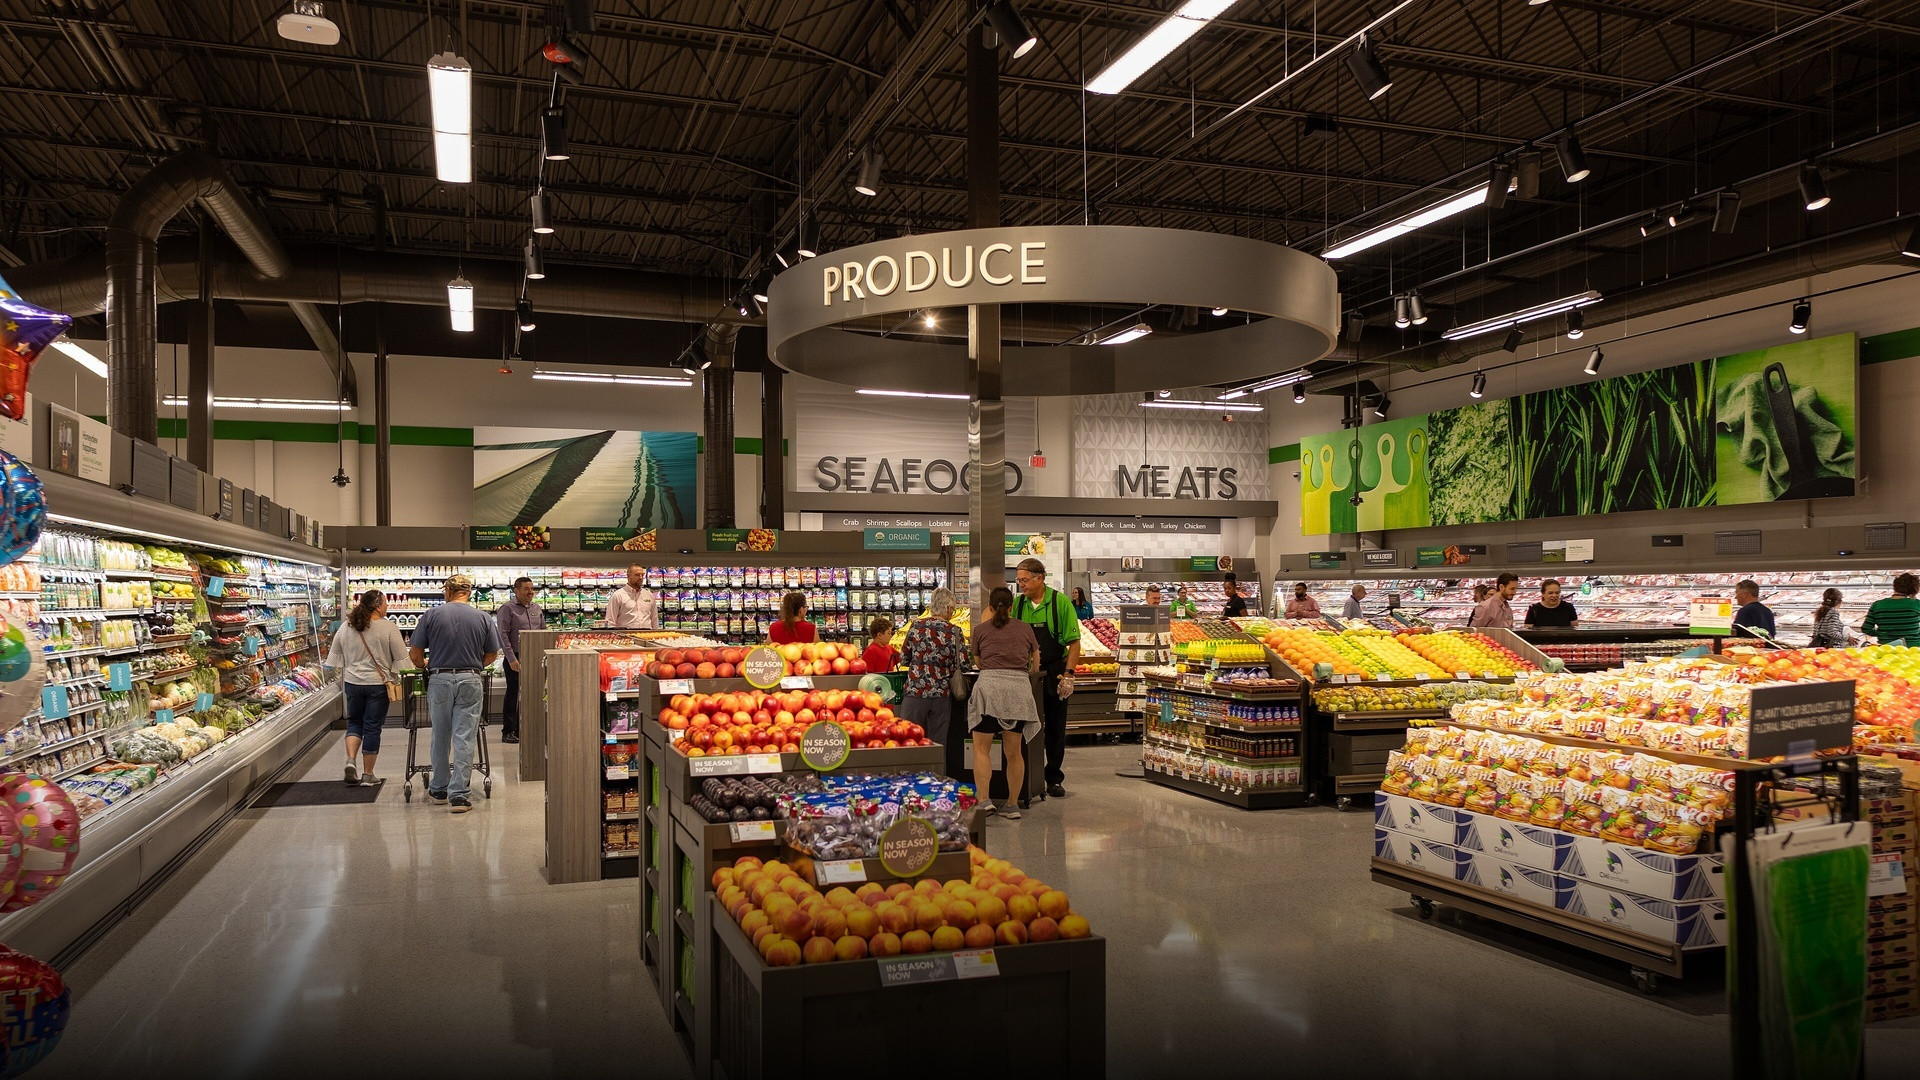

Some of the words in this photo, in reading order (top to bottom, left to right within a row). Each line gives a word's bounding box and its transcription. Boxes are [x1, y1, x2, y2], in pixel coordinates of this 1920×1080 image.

[824, 242, 1047, 306] PRODUCE
[818, 456, 1023, 494] SEAFOD
[1119, 465, 1238, 499] MEATS
[866, 519, 889, 527] Shrimp
[1160, 523, 1179, 531] Turkey
[50, 690, 59, 713] ORGANIC
[804, 746, 825, 754] NOW
[883, 842, 894, 850] IN
[895, 837, 934, 849] SEASON
[883, 849, 908, 859] NOW
[886, 964, 896, 973] IN
[897, 961, 934, 971] SEASON
[887, 971, 911, 981] NOW
[0, 987, 41, 1023] ET
